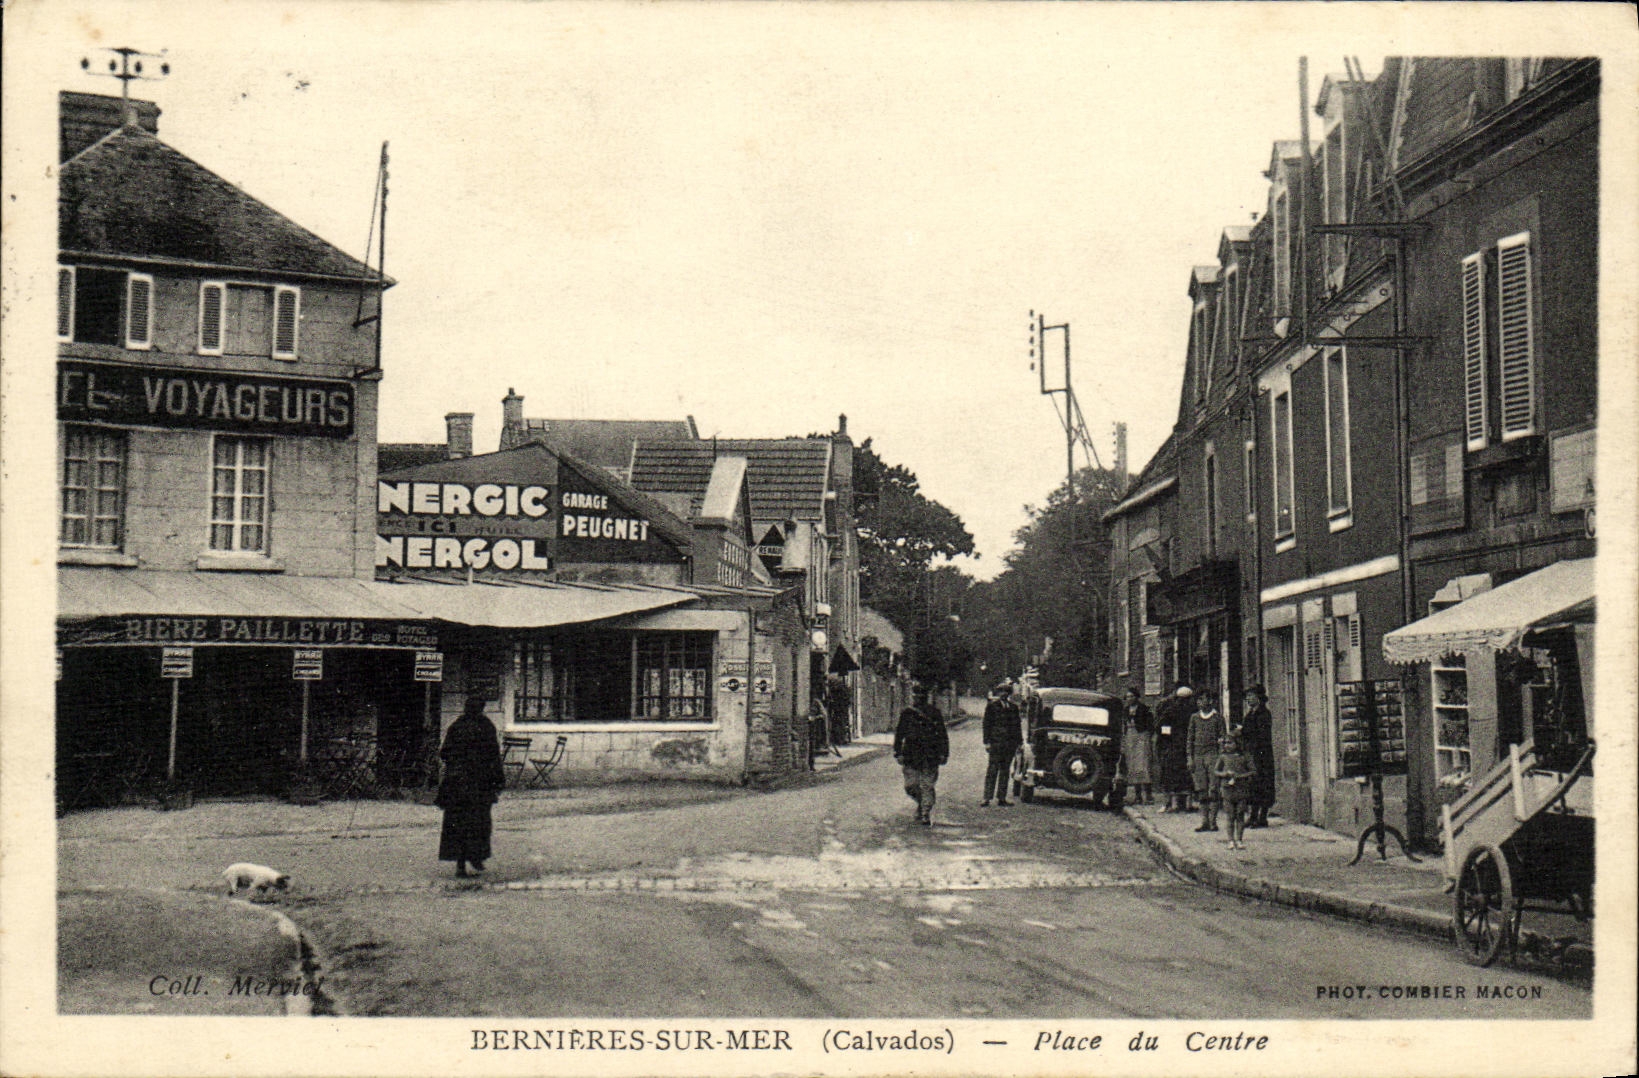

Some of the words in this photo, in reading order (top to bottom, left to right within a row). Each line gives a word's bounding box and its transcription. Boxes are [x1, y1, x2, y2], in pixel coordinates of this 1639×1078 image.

[143, 376, 350, 427] VOYAGEURS
[377, 481, 549, 517] NERGIC
[562, 492, 608, 510] GARAGE
[417, 520, 457, 533] ICI
[562, 515, 649, 541] PEUGNET
[375, 535, 548, 571] NERGOL
[125, 618, 208, 640] BIERE
[220, 618, 365, 643] PAILLETTE
